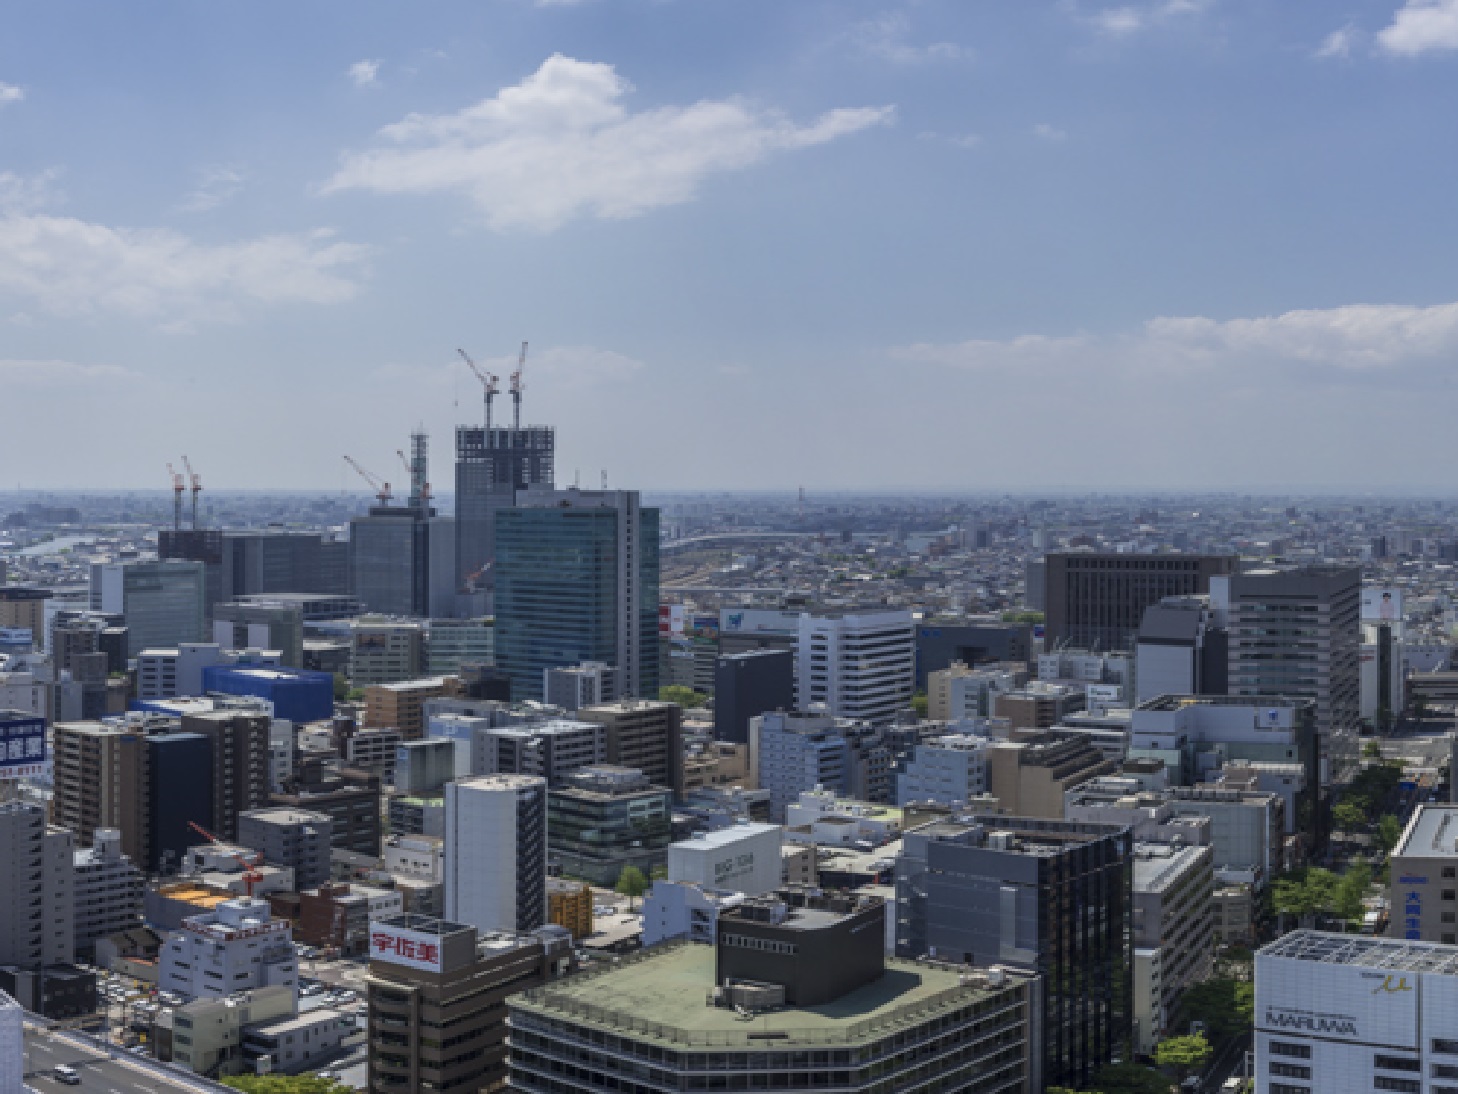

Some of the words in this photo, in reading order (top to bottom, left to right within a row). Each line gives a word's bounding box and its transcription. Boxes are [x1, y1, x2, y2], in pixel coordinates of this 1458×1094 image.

[372, 933, 440, 965] 宇佐美
[1265, 1012, 1359, 1037] MARUWA
